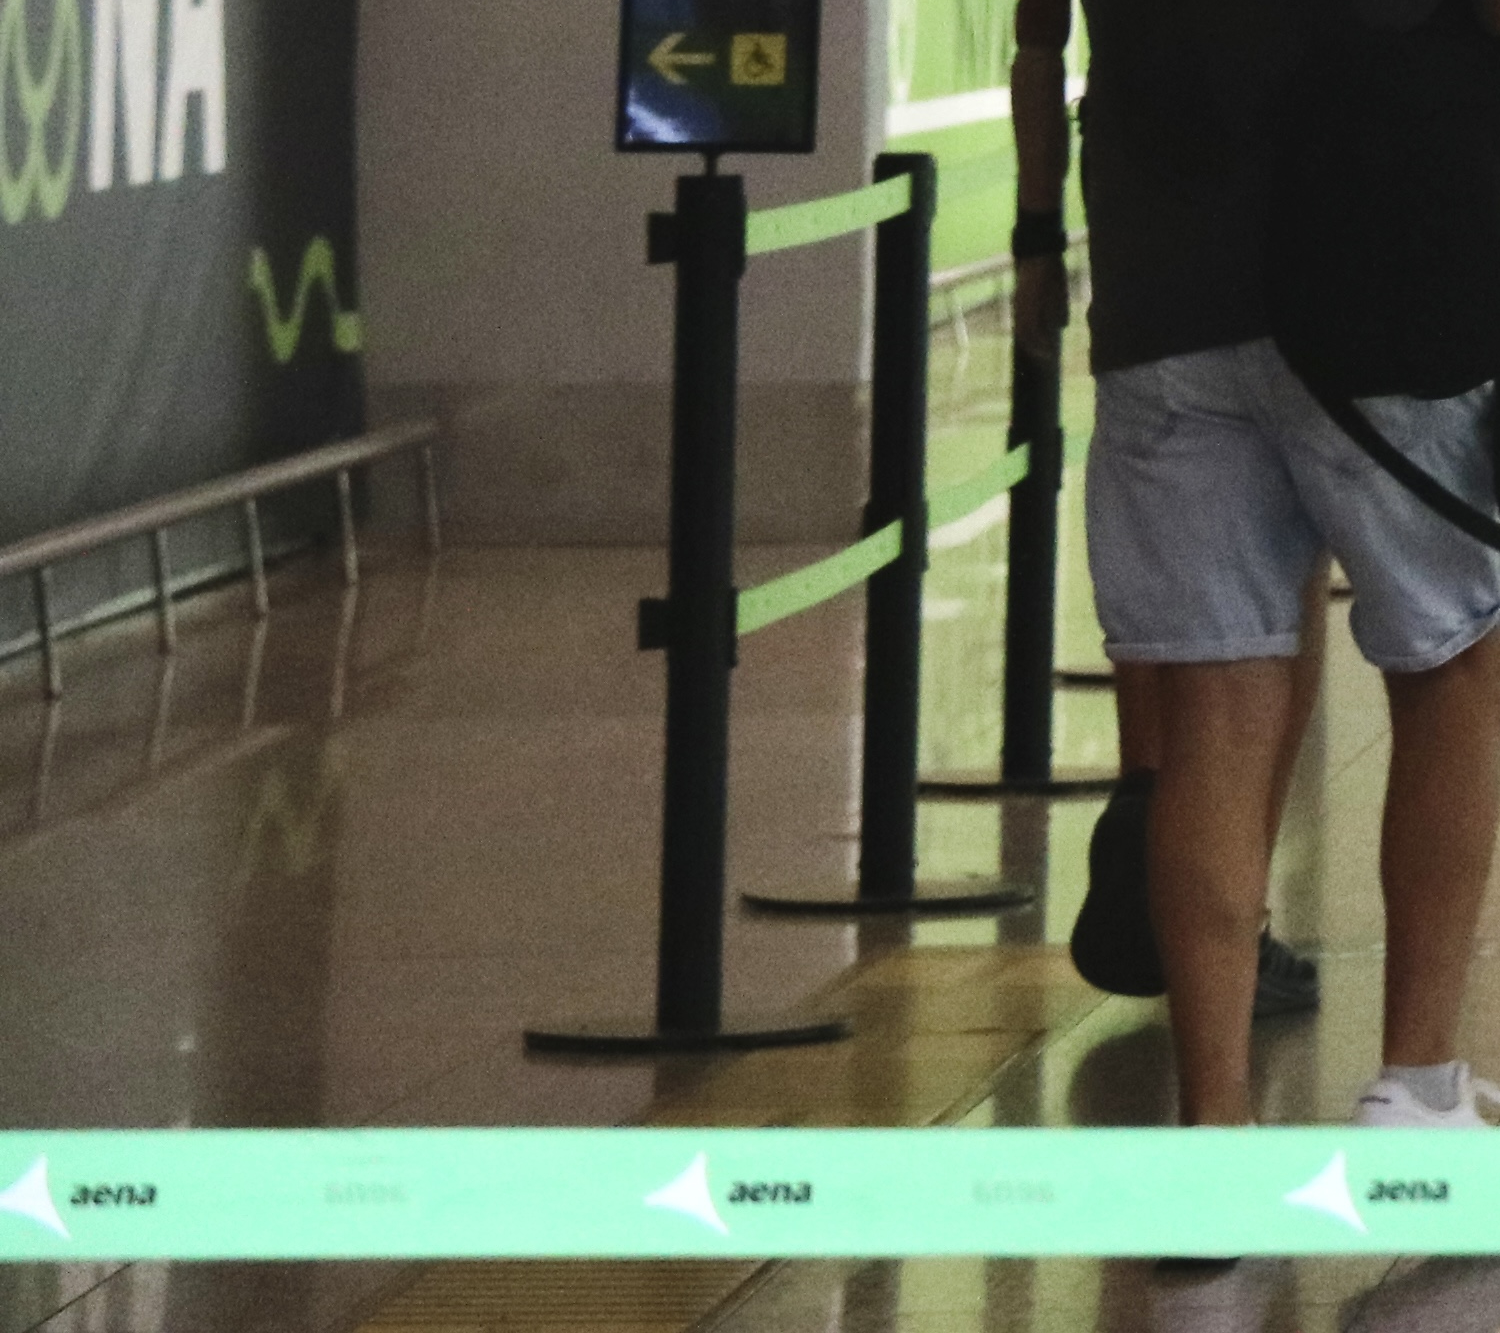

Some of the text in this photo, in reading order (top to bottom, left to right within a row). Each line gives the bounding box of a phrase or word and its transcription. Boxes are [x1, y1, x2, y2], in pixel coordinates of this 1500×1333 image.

[69, 1184, 158, 1207] aena
[727, 1181, 813, 1206] aena
[1366, 1180, 1451, 1204] aena
